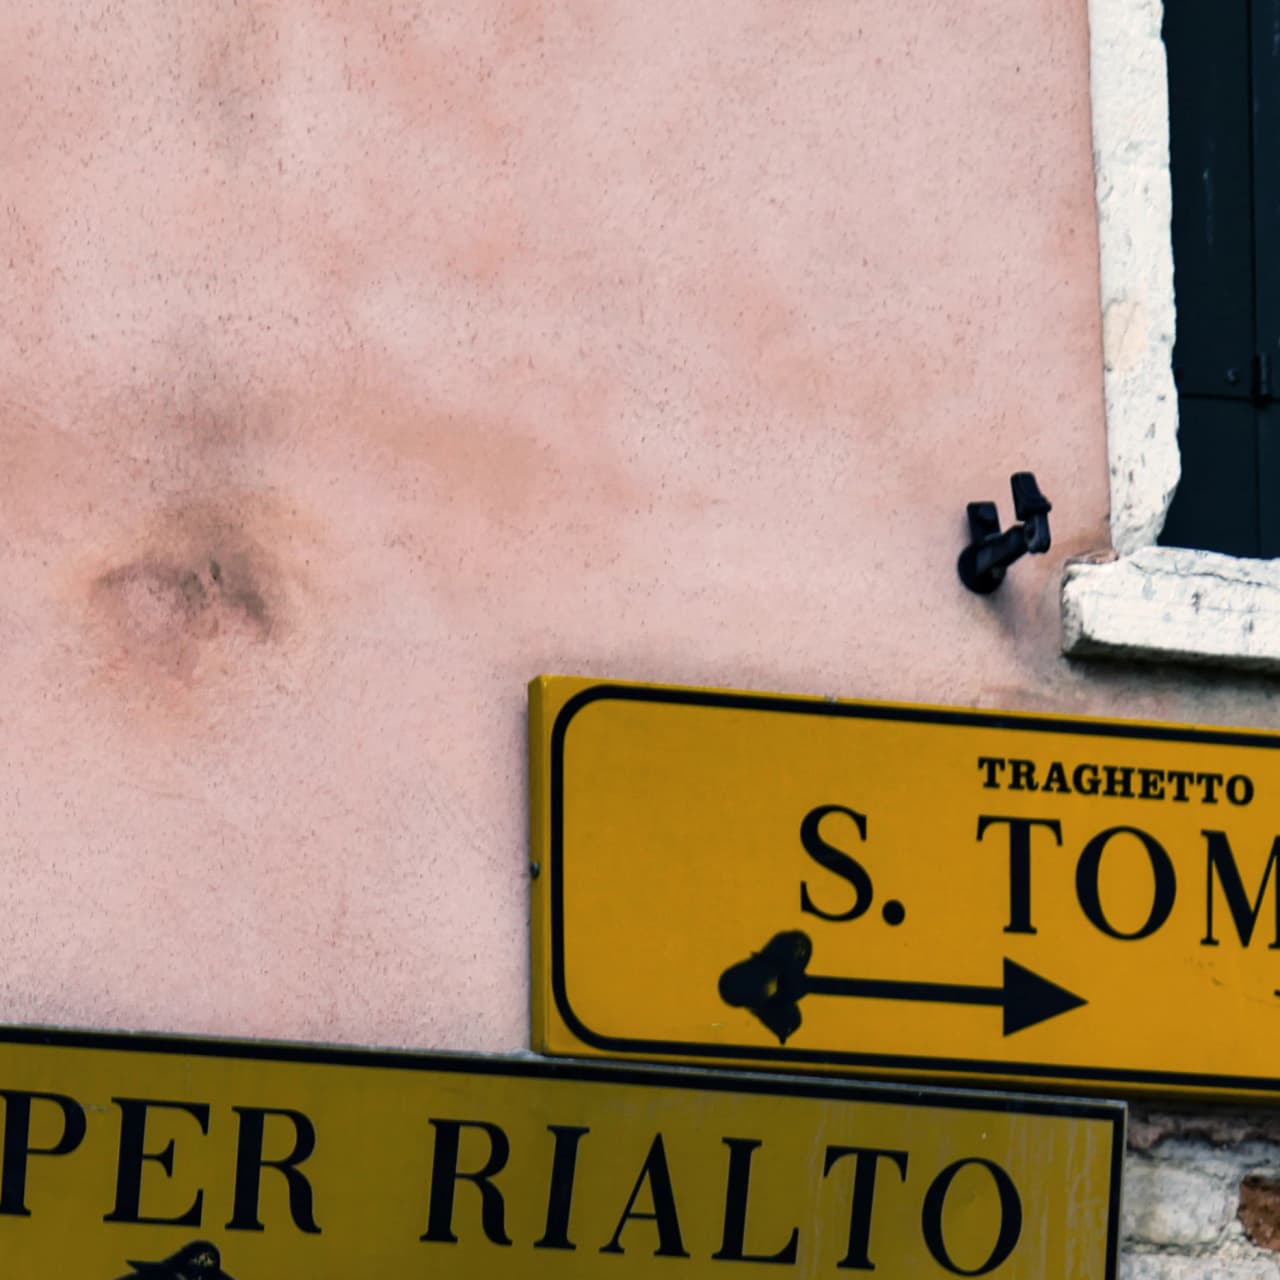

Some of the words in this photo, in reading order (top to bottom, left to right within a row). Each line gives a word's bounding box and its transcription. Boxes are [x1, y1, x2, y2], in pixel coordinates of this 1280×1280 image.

[977, 757, 1255, 806] TRAGHETTO
[800, 804, 905, 926] S.
[419, 1117, 1023, 1278] RIALTO
